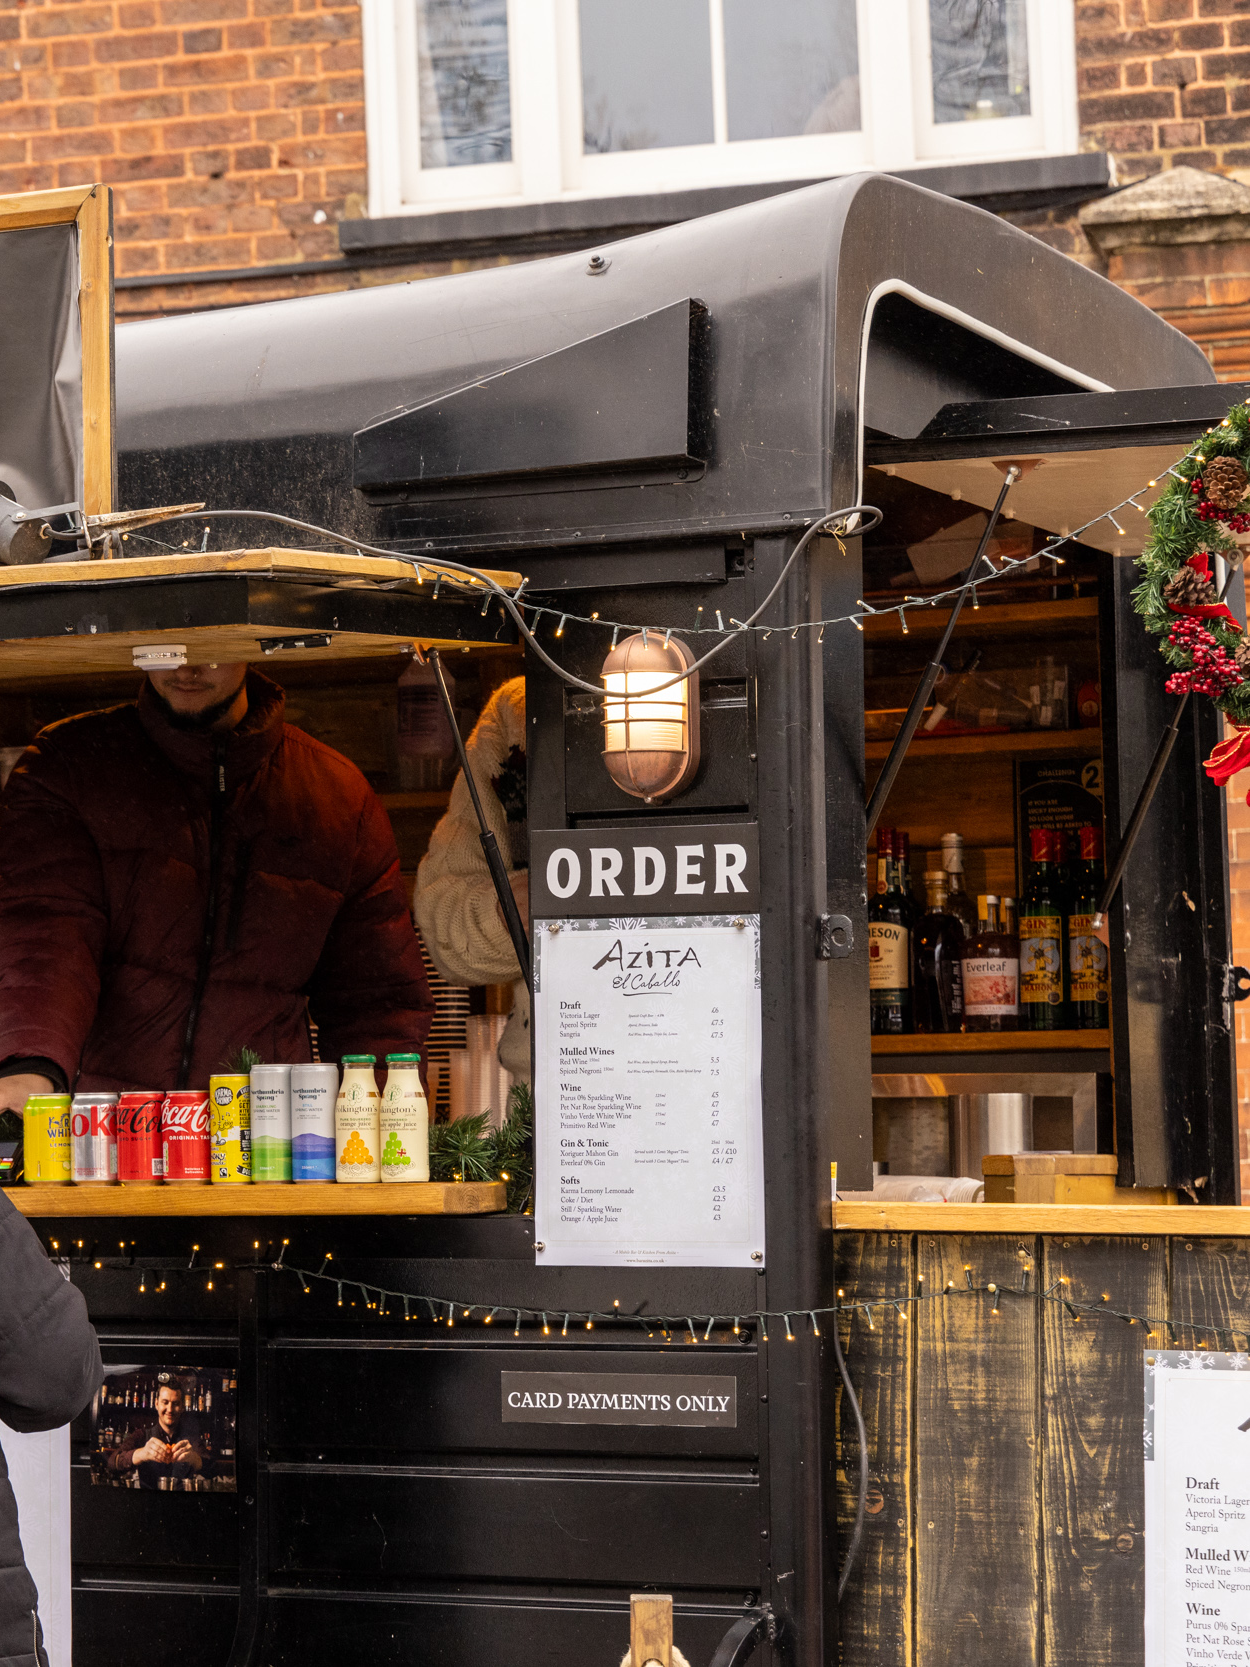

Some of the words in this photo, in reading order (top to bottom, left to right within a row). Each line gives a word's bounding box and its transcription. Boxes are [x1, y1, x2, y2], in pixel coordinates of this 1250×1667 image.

[547, 844, 749, 898] ORDER
[1027, 920, 1046, 930] GIN
[966, 961, 1006, 972] Everleaf
[631, 971, 680, 990] Caballo
[560, 1001, 581, 1009] Draft
[584, 1012, 600, 1020] Lager
[560, 1021, 578, 1030] Aperol
[580, 1021, 597, 1030] Spritz
[560, 1031, 580, 1039] Sangria
[560, 1047, 587, 1056] Mulled
[589, 1047, 614, 1055] Wines
[560, 1068, 577, 1076] Spiced
[579, 1067, 602, 1076] Negroni
[560, 1084, 581, 1092] Wine
[588, 1094, 614, 1102] Sparkling
[597, 1103, 624, 1111] Sparkling
[560, 1139, 575, 1147] Gin
[577, 1139, 585, 1147] &
[587, 1139, 609, 1147] Tonic
[560, 1150, 584, 1158] Xoriguer
[560, 1176, 580, 1184] Softs
[580, 1187, 603, 1195] Lemony
[577, 1206, 603, 1214] Sparkling
[561, 1215, 581, 1223] Orange
[587, 1215, 603, 1223] Apple
[604, 1215, 618, 1223] Juice
[508, 1391, 562, 1408] CARD
[567, 1393, 671, 1411] PAYMENTS
[675, 1395, 730, 1412] ONLY
[1185, 1477, 1220, 1490] Draft
[1185, 1494, 1221, 1504] Victoria
[1185, 1508, 1215, 1520] Aperol
[1218, 1509, 1245, 1521] Spritz
[1185, 1522, 1218, 1535] Sangria
[1185, 1548, 1230, 1561] Mulled
[1185, 1564, 1203, 1574] Red
[1205, 1565, 1231, 1575] Wine
[1185, 1578, 1214, 1591] Spiced
[1186, 1602, 1221, 1616] Wine
[1186, 1619, 1211, 1630] Purus
[1214, 1621, 1228, 1631] 0%
[1186, 1633, 1200, 1643] Pet
[1203, 1634, 1220, 1645] Nat
[1223, 1636, 1244, 1646] Rose
[1186, 1647, 1214, 1658] Vinho
[1217, 1649, 1242, 1660] Verde
